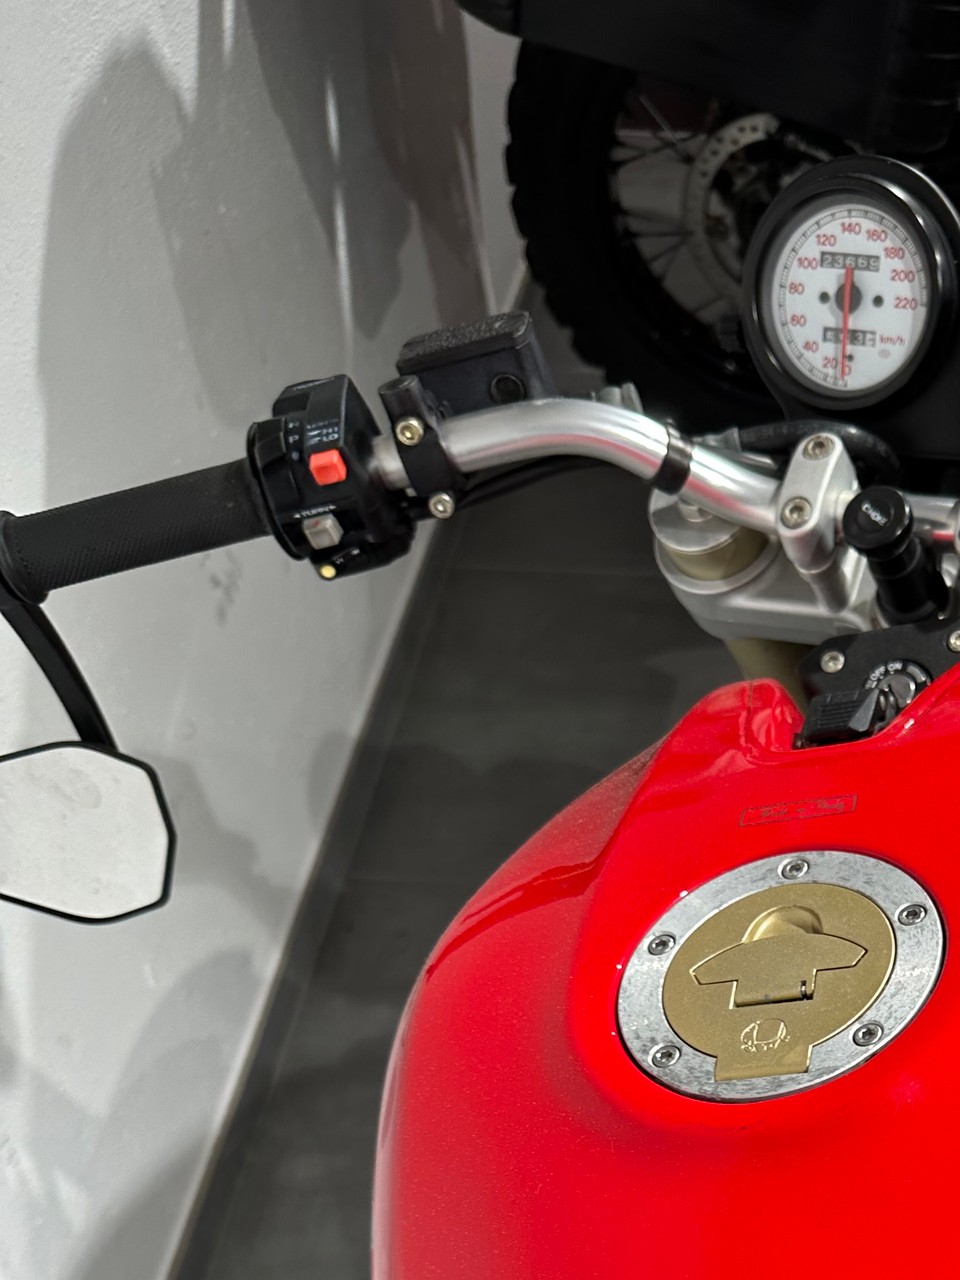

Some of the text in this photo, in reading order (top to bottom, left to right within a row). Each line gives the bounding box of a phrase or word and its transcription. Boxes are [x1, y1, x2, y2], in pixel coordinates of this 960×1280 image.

[841, 222, 862, 235] 140
[816, 234, 837, 247] 120
[866, 229, 888, 242] 160
[884, 247, 905, 260] 180
[797, 257, 818, 270] 100
[891, 269, 915, 282] 200
[789, 282, 805, 295] 80
[895, 297, 918, 310] 220
[790, 314, 807, 327] 60
[879, 333, 905, 346] km/h
[803, 341, 819, 353] 40
[823, 356, 839, 369] 20
